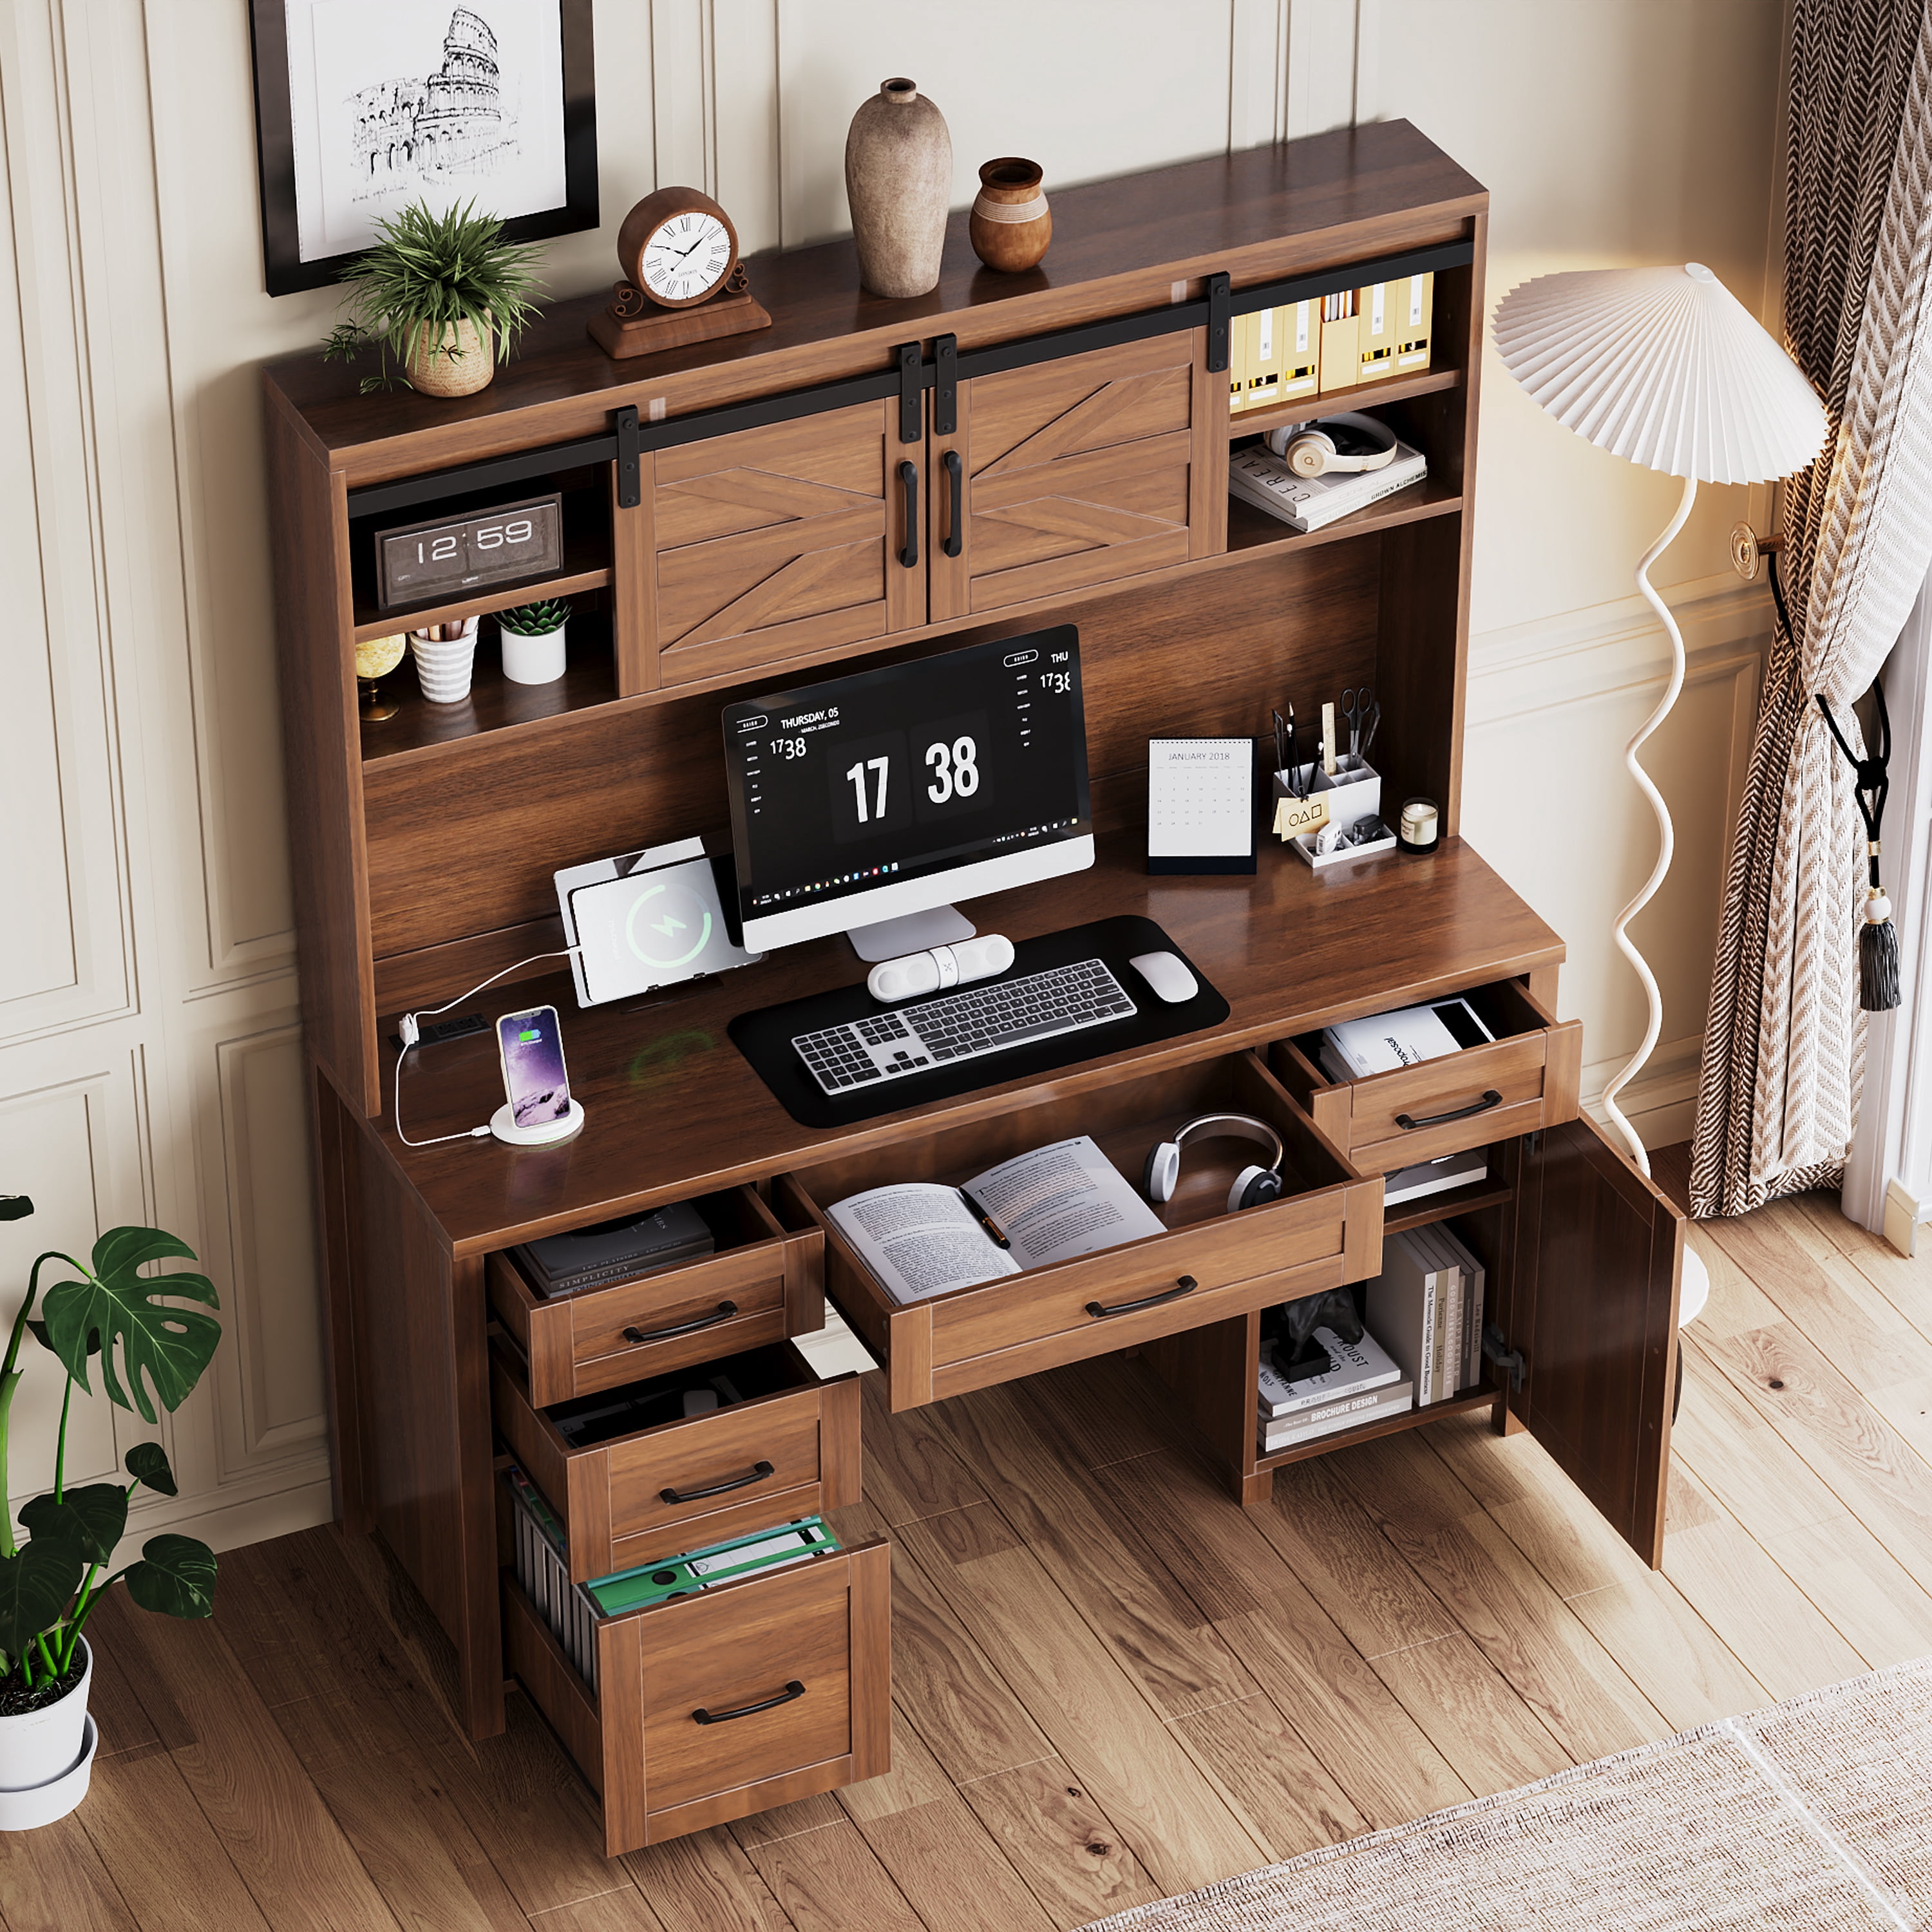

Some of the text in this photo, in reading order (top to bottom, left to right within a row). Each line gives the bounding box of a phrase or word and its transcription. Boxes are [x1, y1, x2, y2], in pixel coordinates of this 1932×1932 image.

[1231, 452, 1311, 502] CEREAL
[1050, 651, 1068, 663] THU
[781, 707, 839, 729] THURSDAY, 05
[847, 736, 979, 823] 17 38
[559, 1265, 629, 1288] SIMPLICITY
[1332, 1334, 1369, 1367] OUST
[1434, 1345, 1443, 1372] Holiday
[1311, 1403, 1350, 1422] BROCHURE
[1352, 1395, 1378, 1409] DESIGN
